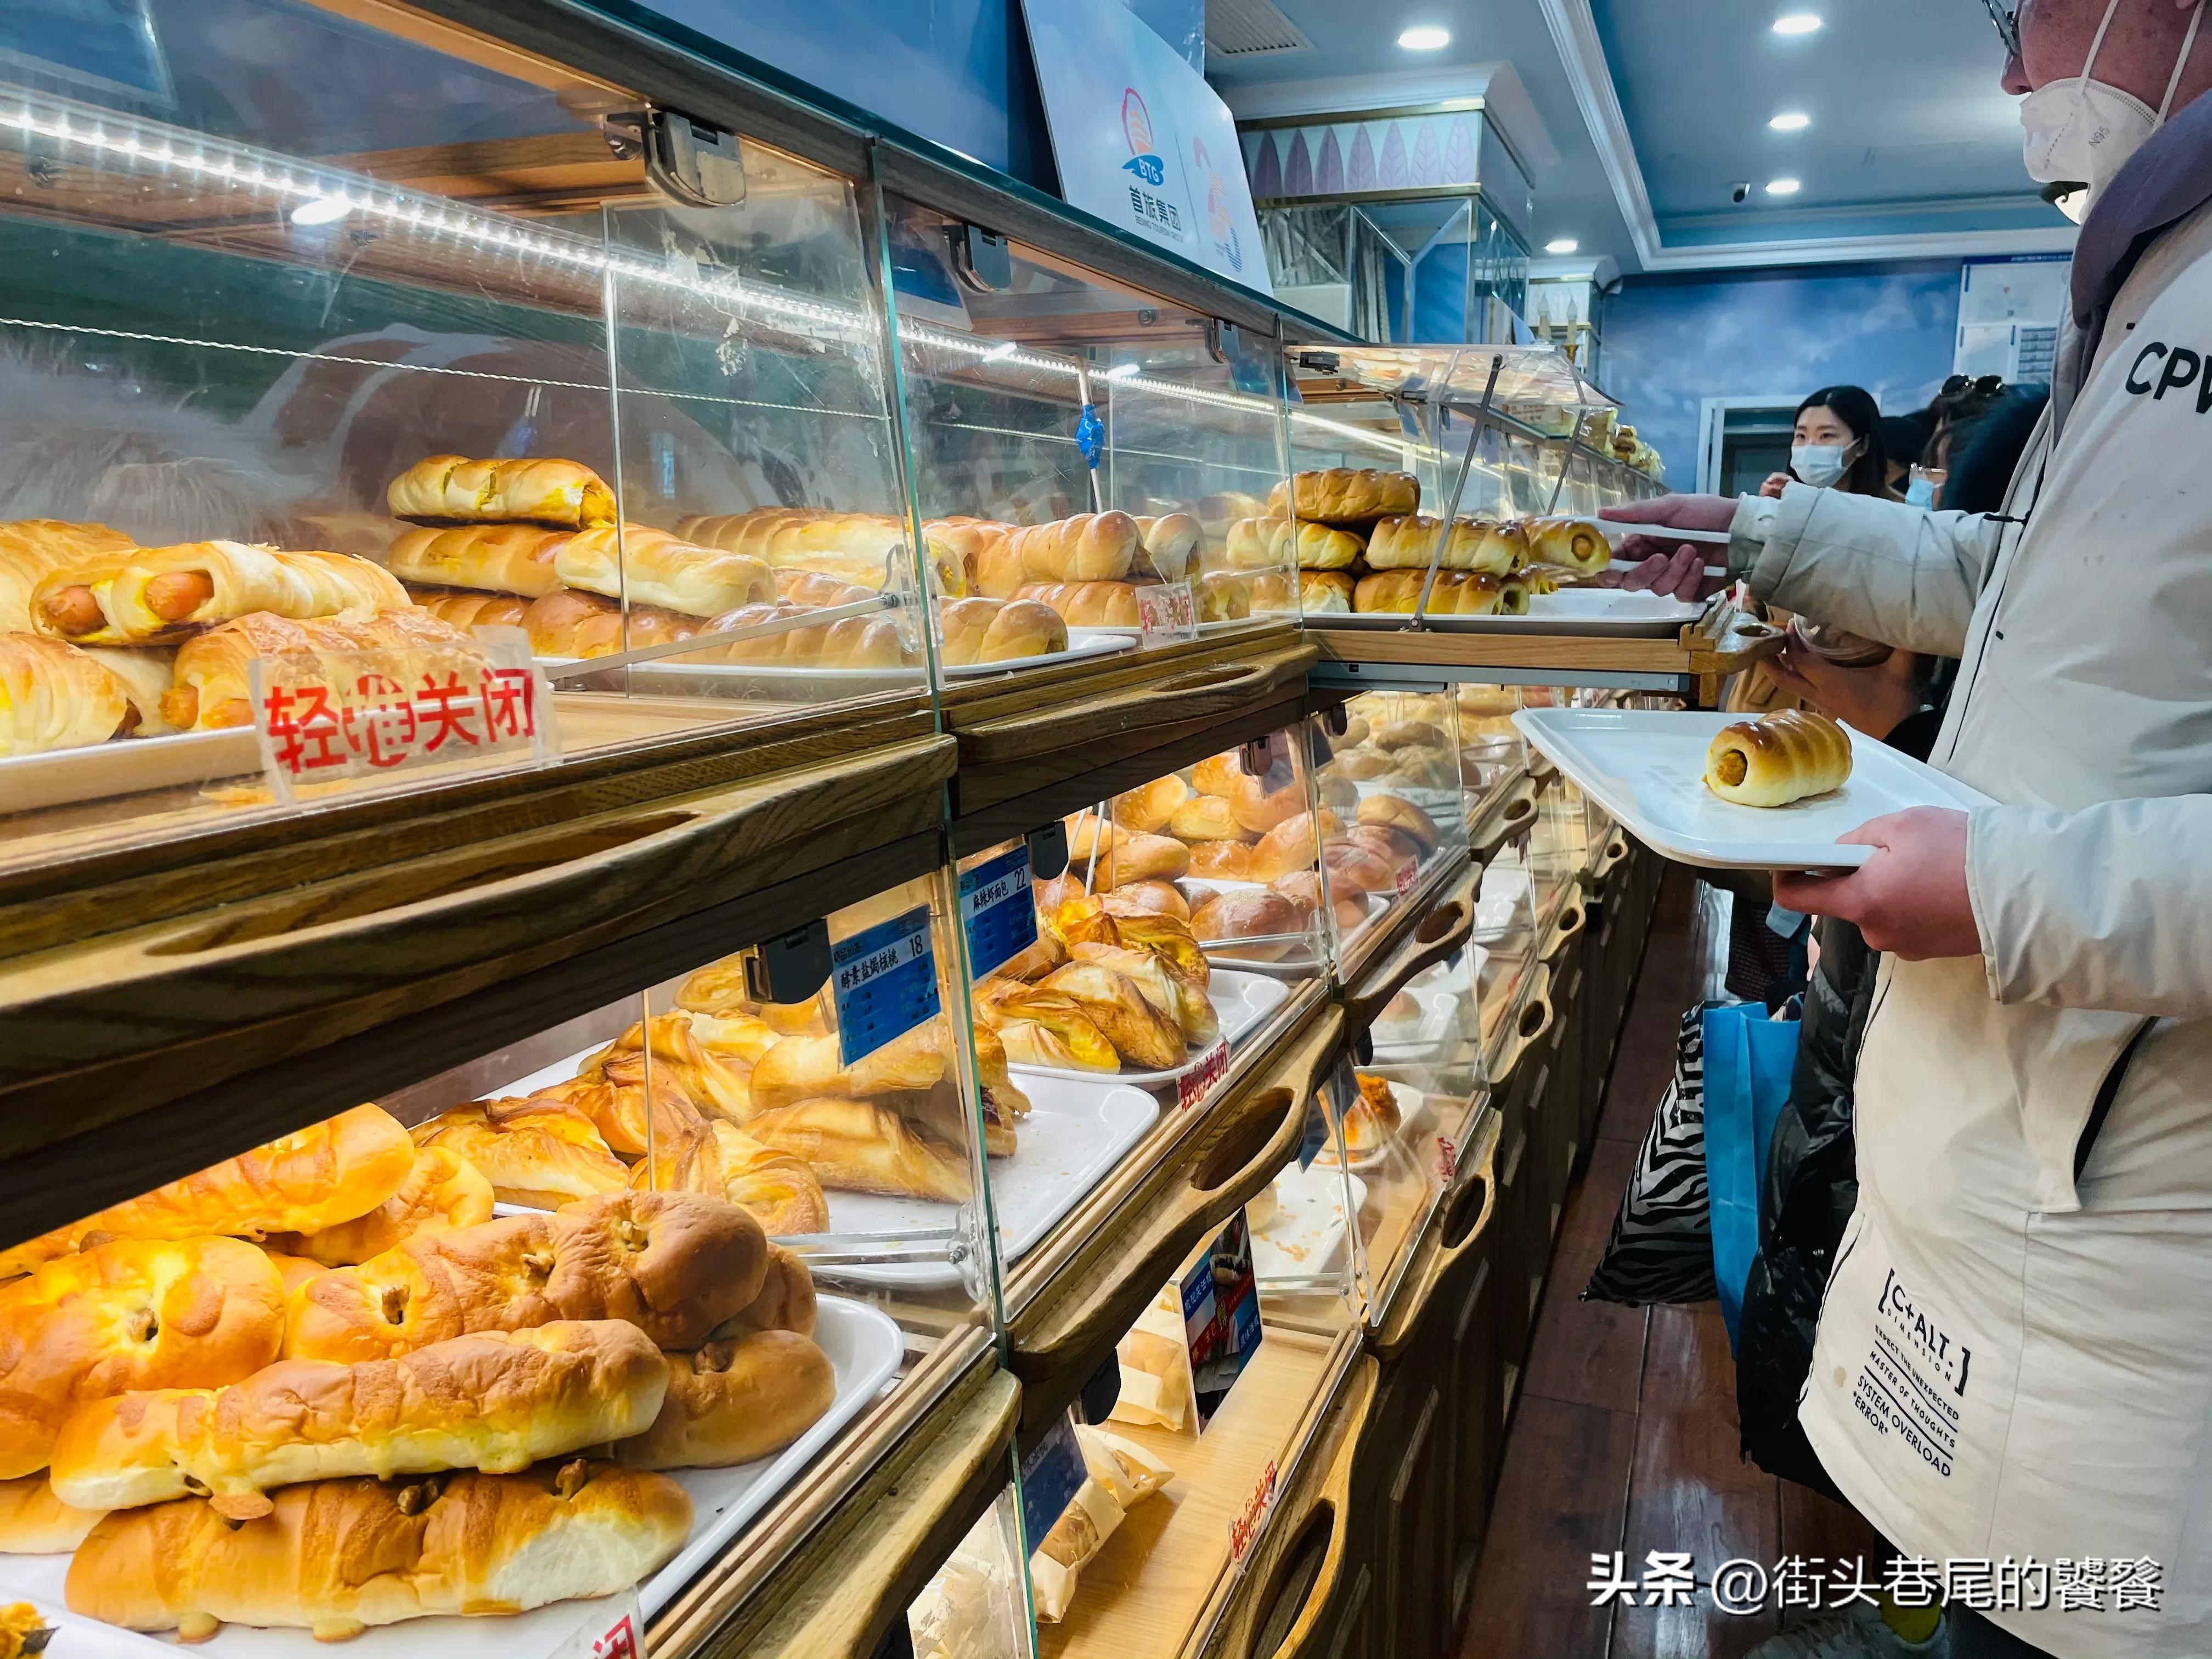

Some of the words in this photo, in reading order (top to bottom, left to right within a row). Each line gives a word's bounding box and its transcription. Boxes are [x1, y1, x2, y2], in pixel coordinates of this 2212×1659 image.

[1138, 157, 1159, 183] BTG
[1128, 184, 1181, 231] 首旅集团
[264, 667, 535, 774] 轻推关闭
[973, 880, 1009, 912] 麻辣虾面包
[1014, 867, 1026, 891] 22
[909, 934, 923, 957] 18
[1875, 1324, 1899, 1355] EXPECT
[1900, 1352, 1912, 1372] THE
[1912, 1368, 1960, 1421] UNEXPECTED
[1887, 1308, 1951, 1382] DIMENSION
[1857, 1375, 1890, 1418] SYSTEM
[1892, 1414, 1951, 1477] OVERLOAD
[1870, 1351, 1898, 1386] MASTER
[1899, 1385, 1909, 1400] OF
[1911, 1398, 1956, 1448] THOUGHTS
